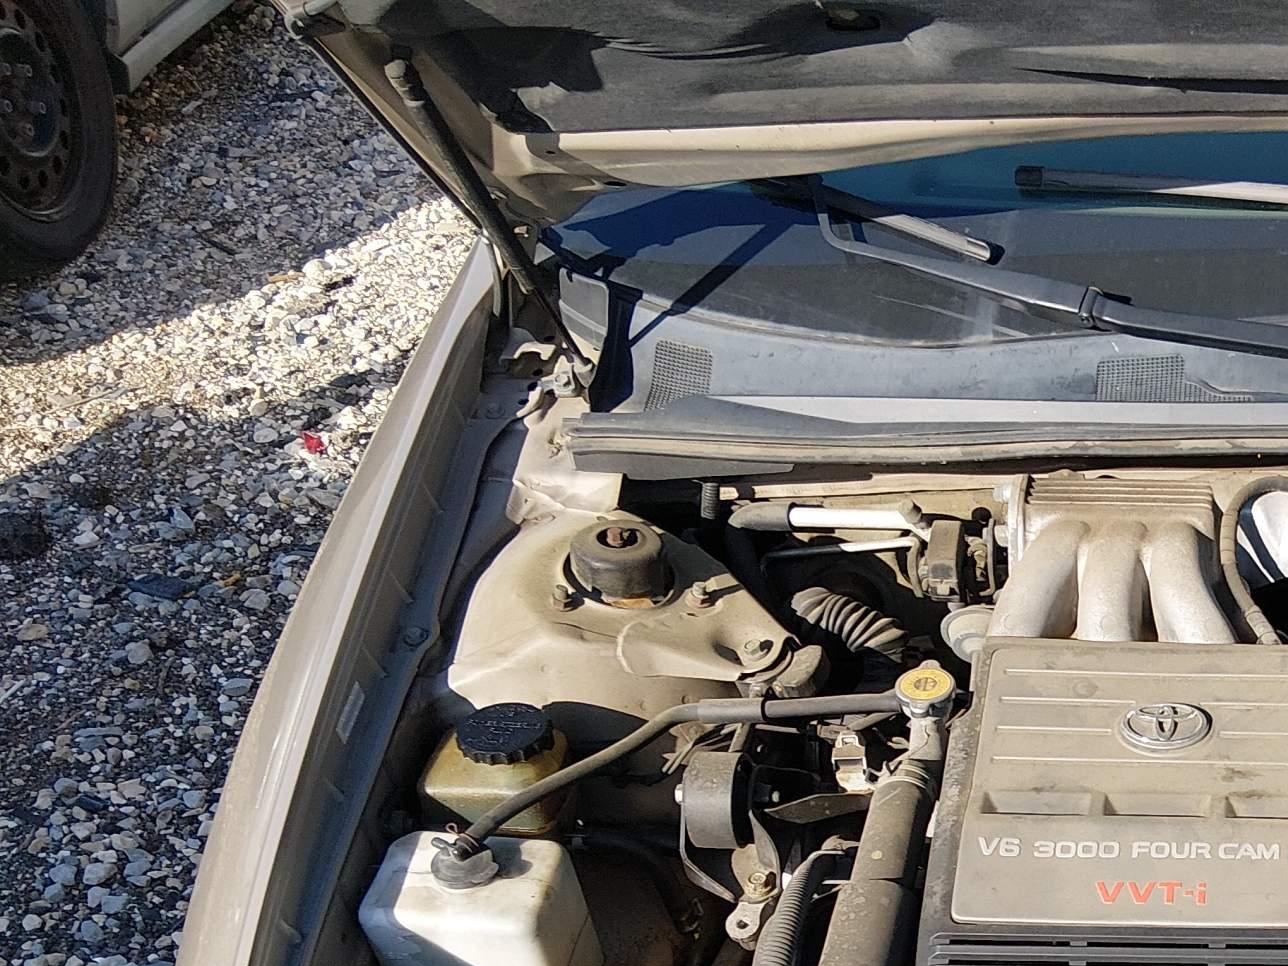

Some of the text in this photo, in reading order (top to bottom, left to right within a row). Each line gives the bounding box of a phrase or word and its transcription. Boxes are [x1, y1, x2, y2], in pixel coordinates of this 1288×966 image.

[977, 835, 1022, 857] V6
[1033, 840, 1120, 859] 3000
[1131, 840, 1212, 860] FOUR
[1217, 842, 1280, 860] CAM
[1095, 880, 1208, 906] VVT-i
